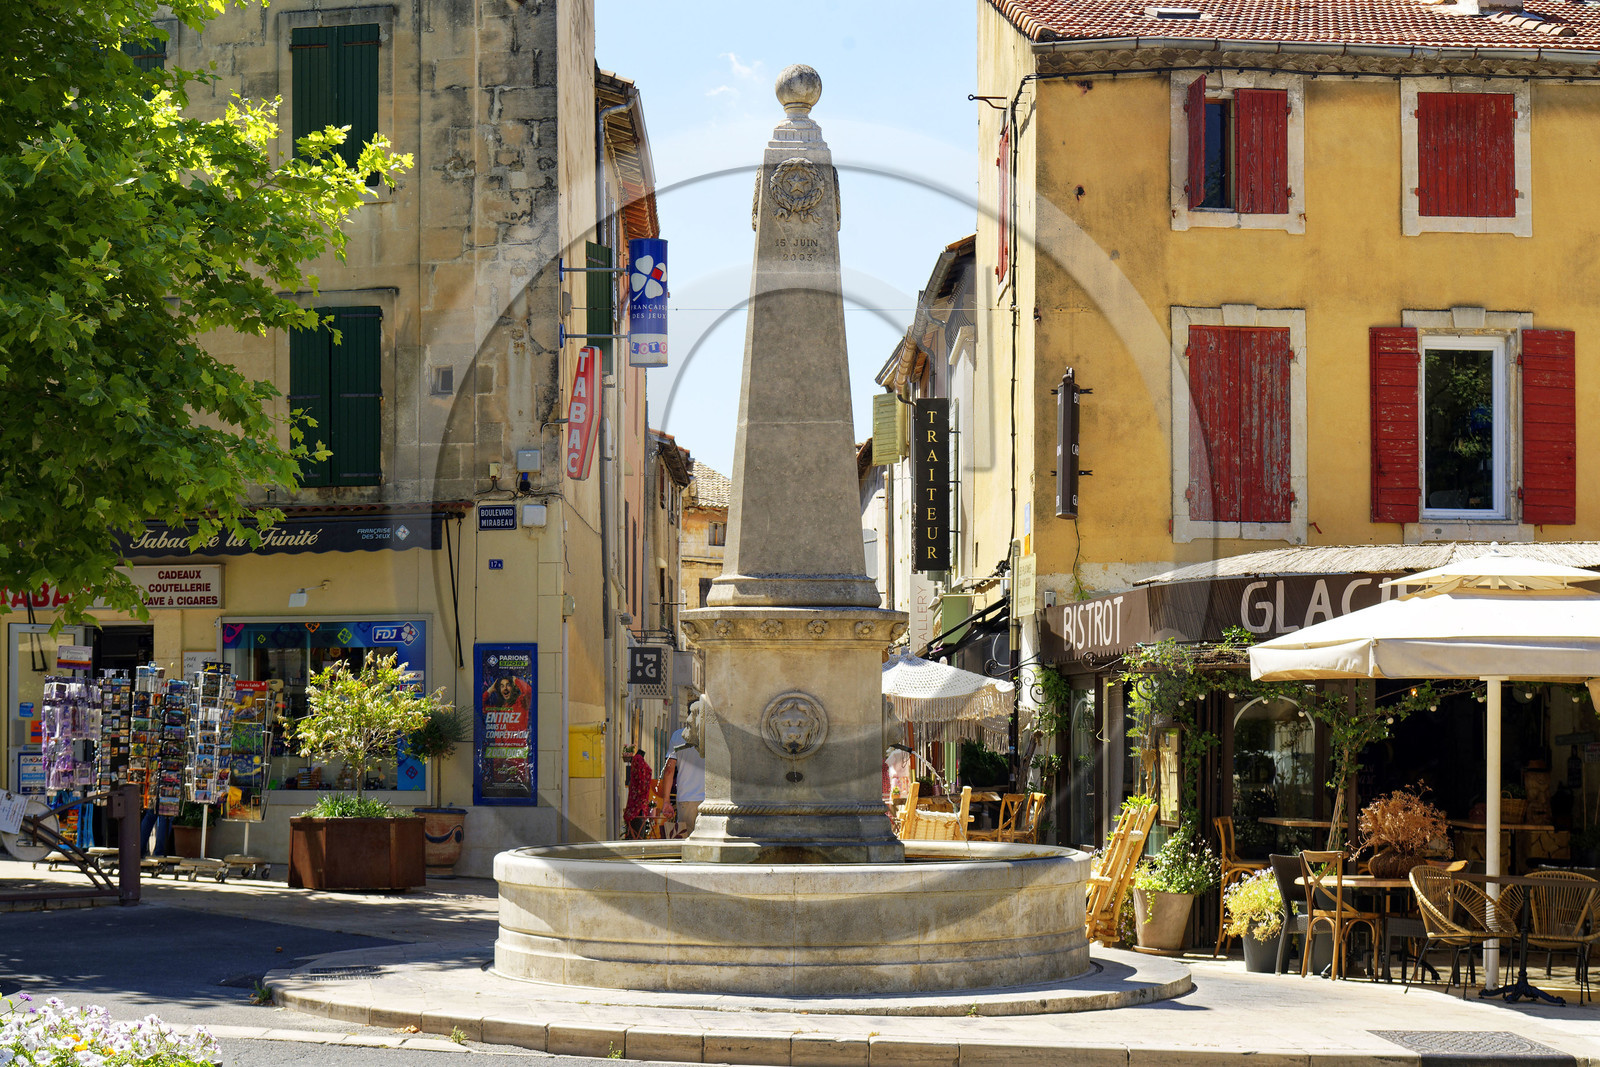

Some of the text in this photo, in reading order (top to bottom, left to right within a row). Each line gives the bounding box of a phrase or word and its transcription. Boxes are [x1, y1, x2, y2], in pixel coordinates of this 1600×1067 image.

[775, 239, 818, 247] 15 JUIN
[631, 342, 667, 354] LOTO
[567, 352, 589, 473] TABAC
[926, 410, 939, 559] TRAITEUR
[480, 508, 514, 517] BOULEVARD
[481, 518, 513, 527] MIRABEAU
[356, 527, 391, 535] FRANÇAISE
[258, 527, 323, 548] Trinité
[158, 570, 202, 580] CADEAUX
[148, 583, 211, 592] COUTELLERIE
[0, 581, 91, 608] ABA
[168, 596, 174, 606] à
[176, 595, 218, 605] CIGARES
[1063, 596, 1123, 651] BISTROT
[375, 629, 398, 640] FDJ
[486, 712, 521, 723] ENTREZ
